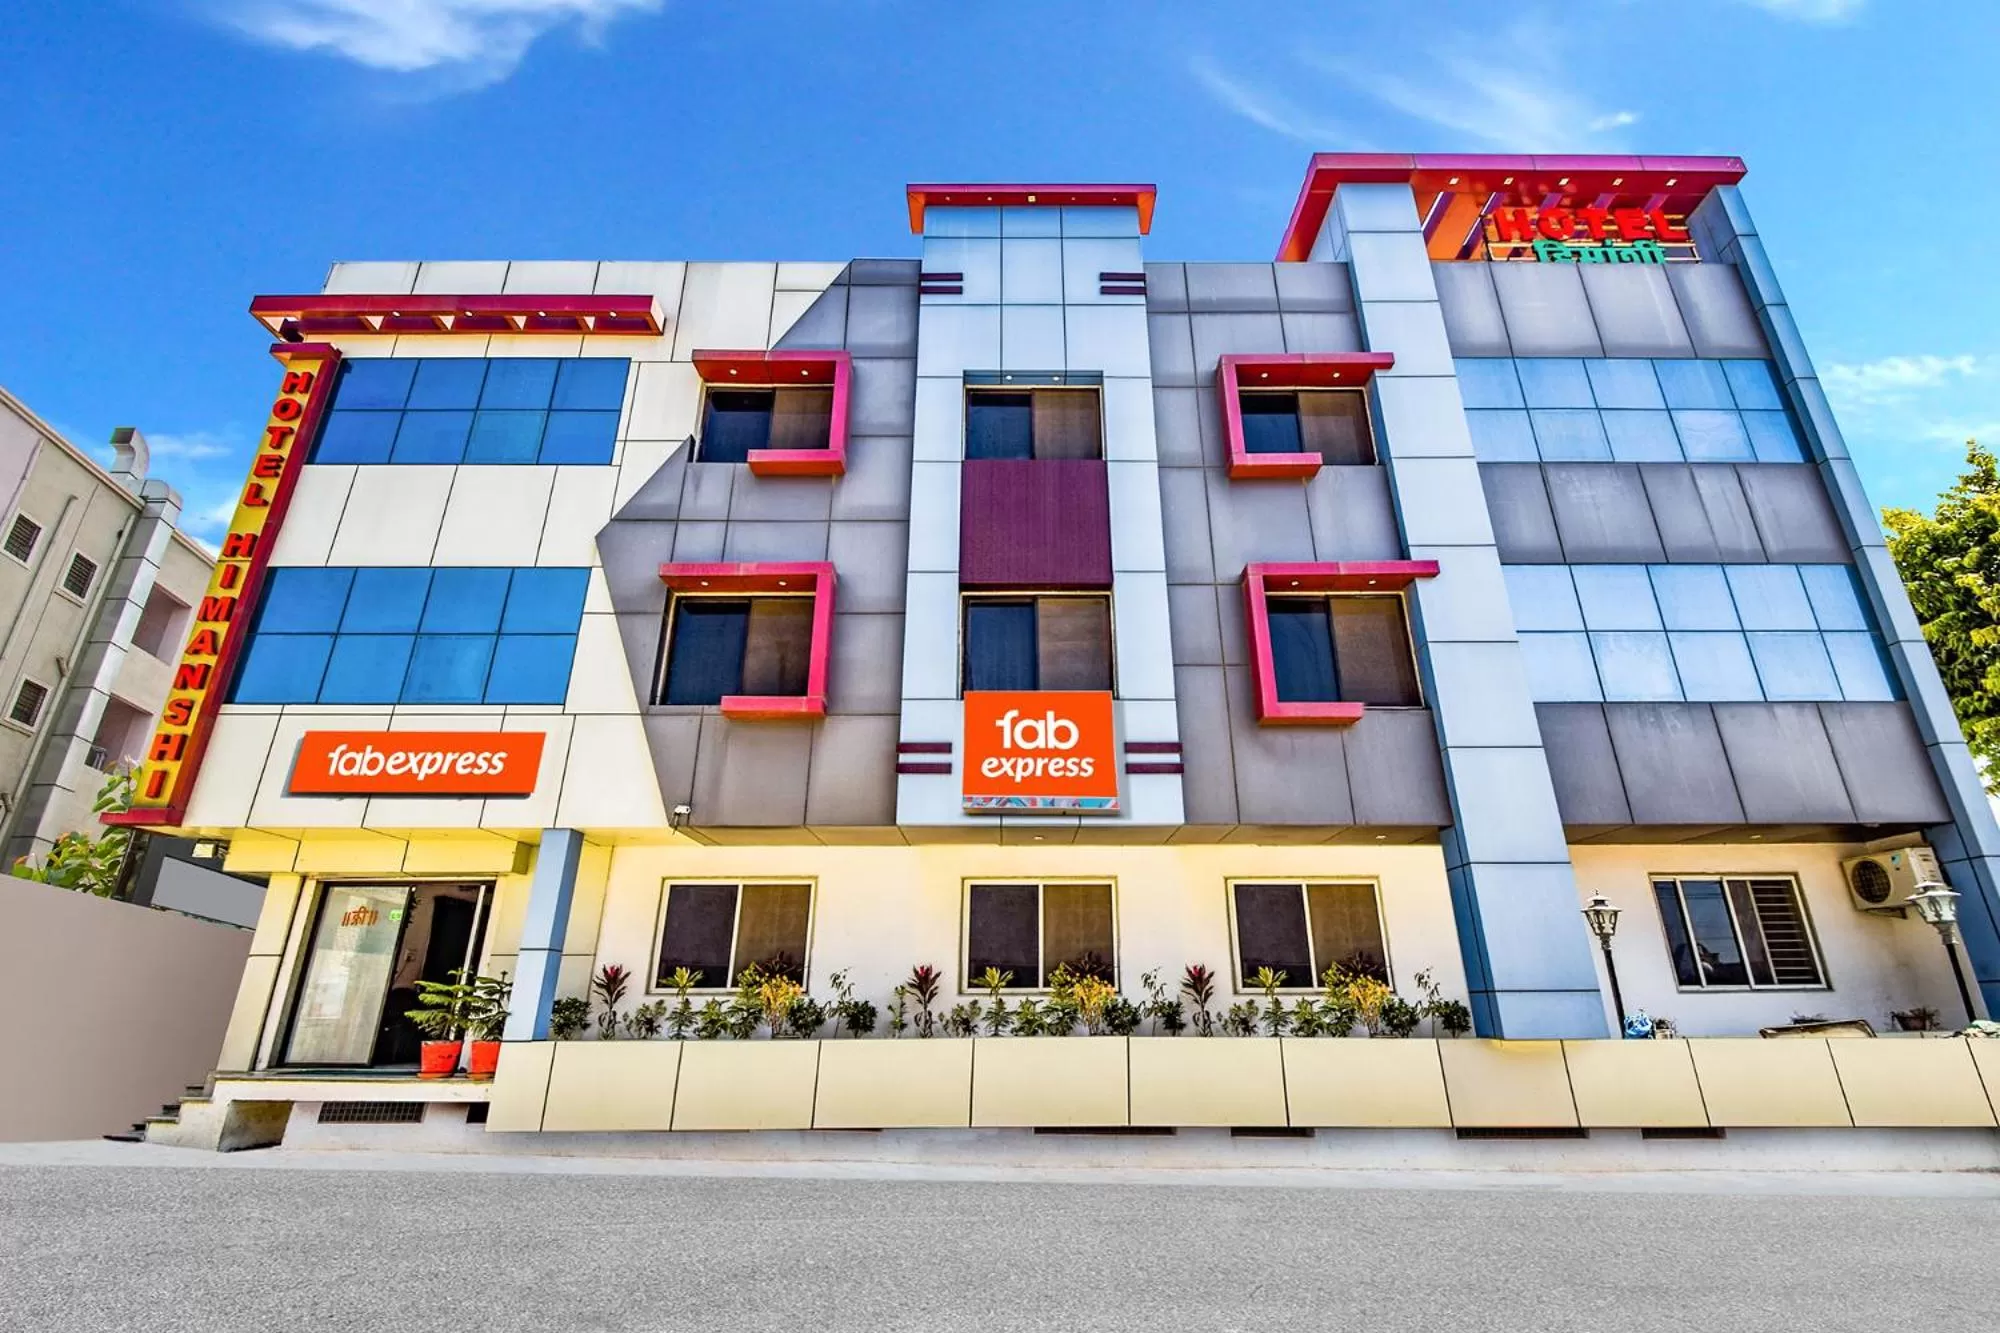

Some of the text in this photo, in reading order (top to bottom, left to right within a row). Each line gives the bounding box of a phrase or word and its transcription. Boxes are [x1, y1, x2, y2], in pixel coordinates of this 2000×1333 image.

[1492, 206, 1688, 241] HOTEL
[147, 371, 314, 799] HOTEL HIMANSHI
[995, 709, 1080, 750] fab
[980, 756, 1096, 783] express
